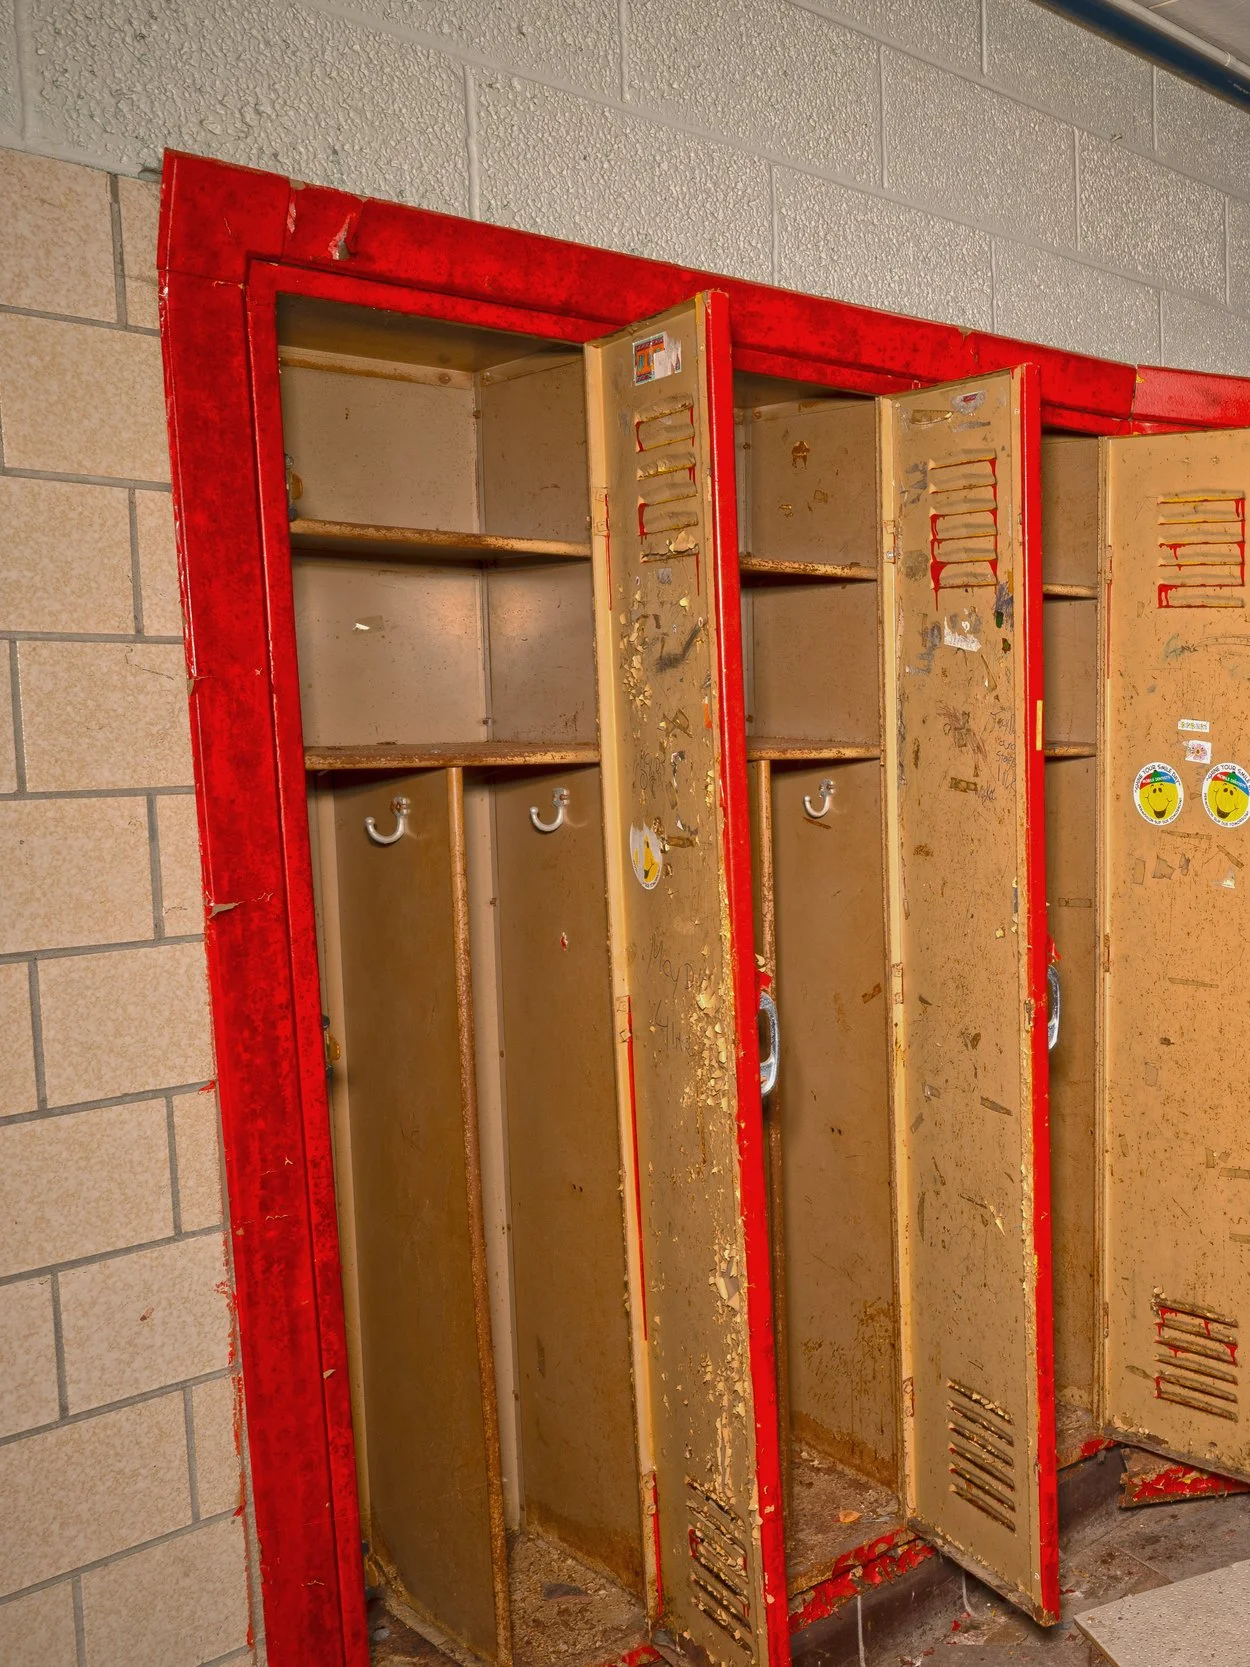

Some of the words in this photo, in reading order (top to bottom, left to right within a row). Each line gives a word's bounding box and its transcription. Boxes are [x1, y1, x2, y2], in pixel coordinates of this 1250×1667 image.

[1142, 764, 1156, 774] YOUR
[1157, 764, 1172, 774] SMILE
[1238, 768, 1250, 784] SMILE
